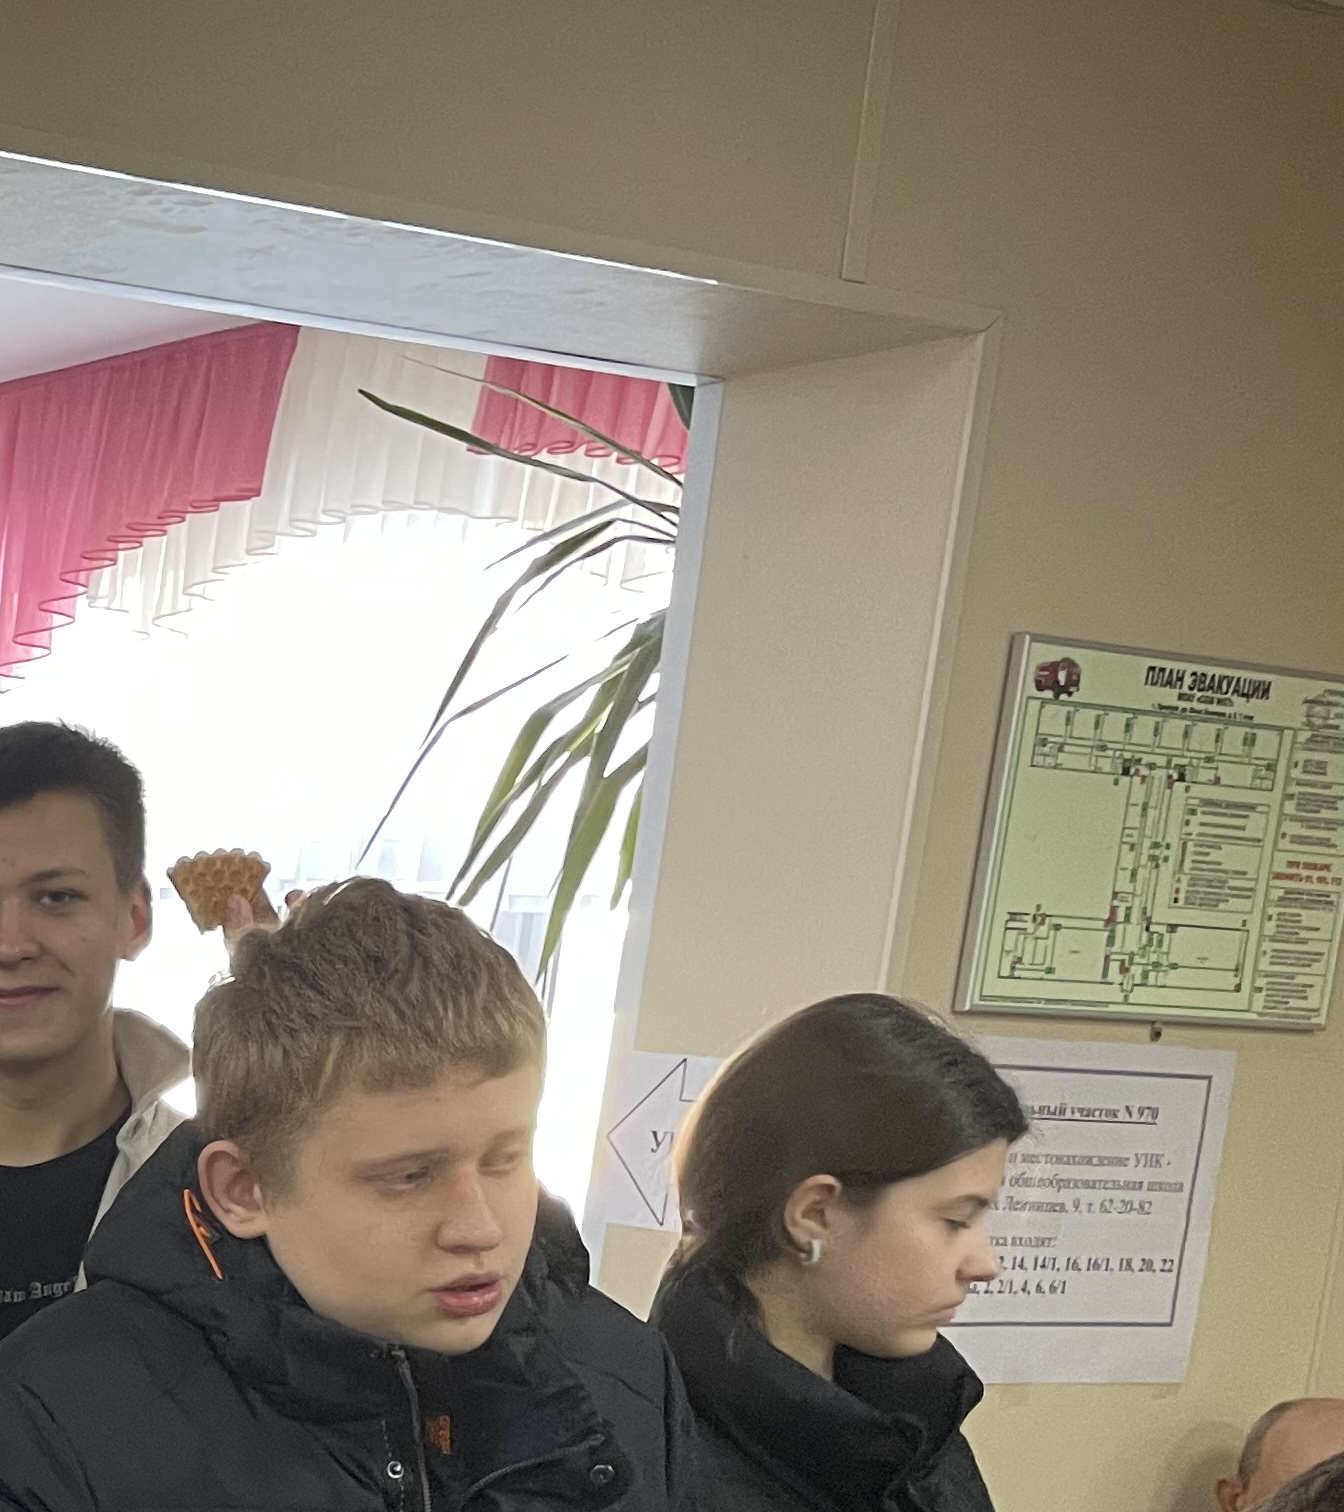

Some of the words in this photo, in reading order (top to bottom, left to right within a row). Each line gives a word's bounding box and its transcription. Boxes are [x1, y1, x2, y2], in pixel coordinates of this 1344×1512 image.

[1144, 666, 1187, 690] ПЛАН
[1188, 671, 1272, 702] ЭВАКУАЦИИ
[1070, 1106, 1120, 1120] участок
[1137, 1106, 1159, 1121] 970
[1133, 1152, 1165, 1168] УИК
[1012, 1256, 1028, 1272] 14,
[1033, 1256, 1061, 1272] 14/1,
[1065, 1257, 1081, 1273] 16,
[1118, 1257, 1134, 1273] 18,
[1138, 1258, 1156, 1274] 20,
[1160, 1258, 1175, 1273] 22
[1049, 1280, 1067, 1295] 6/1
